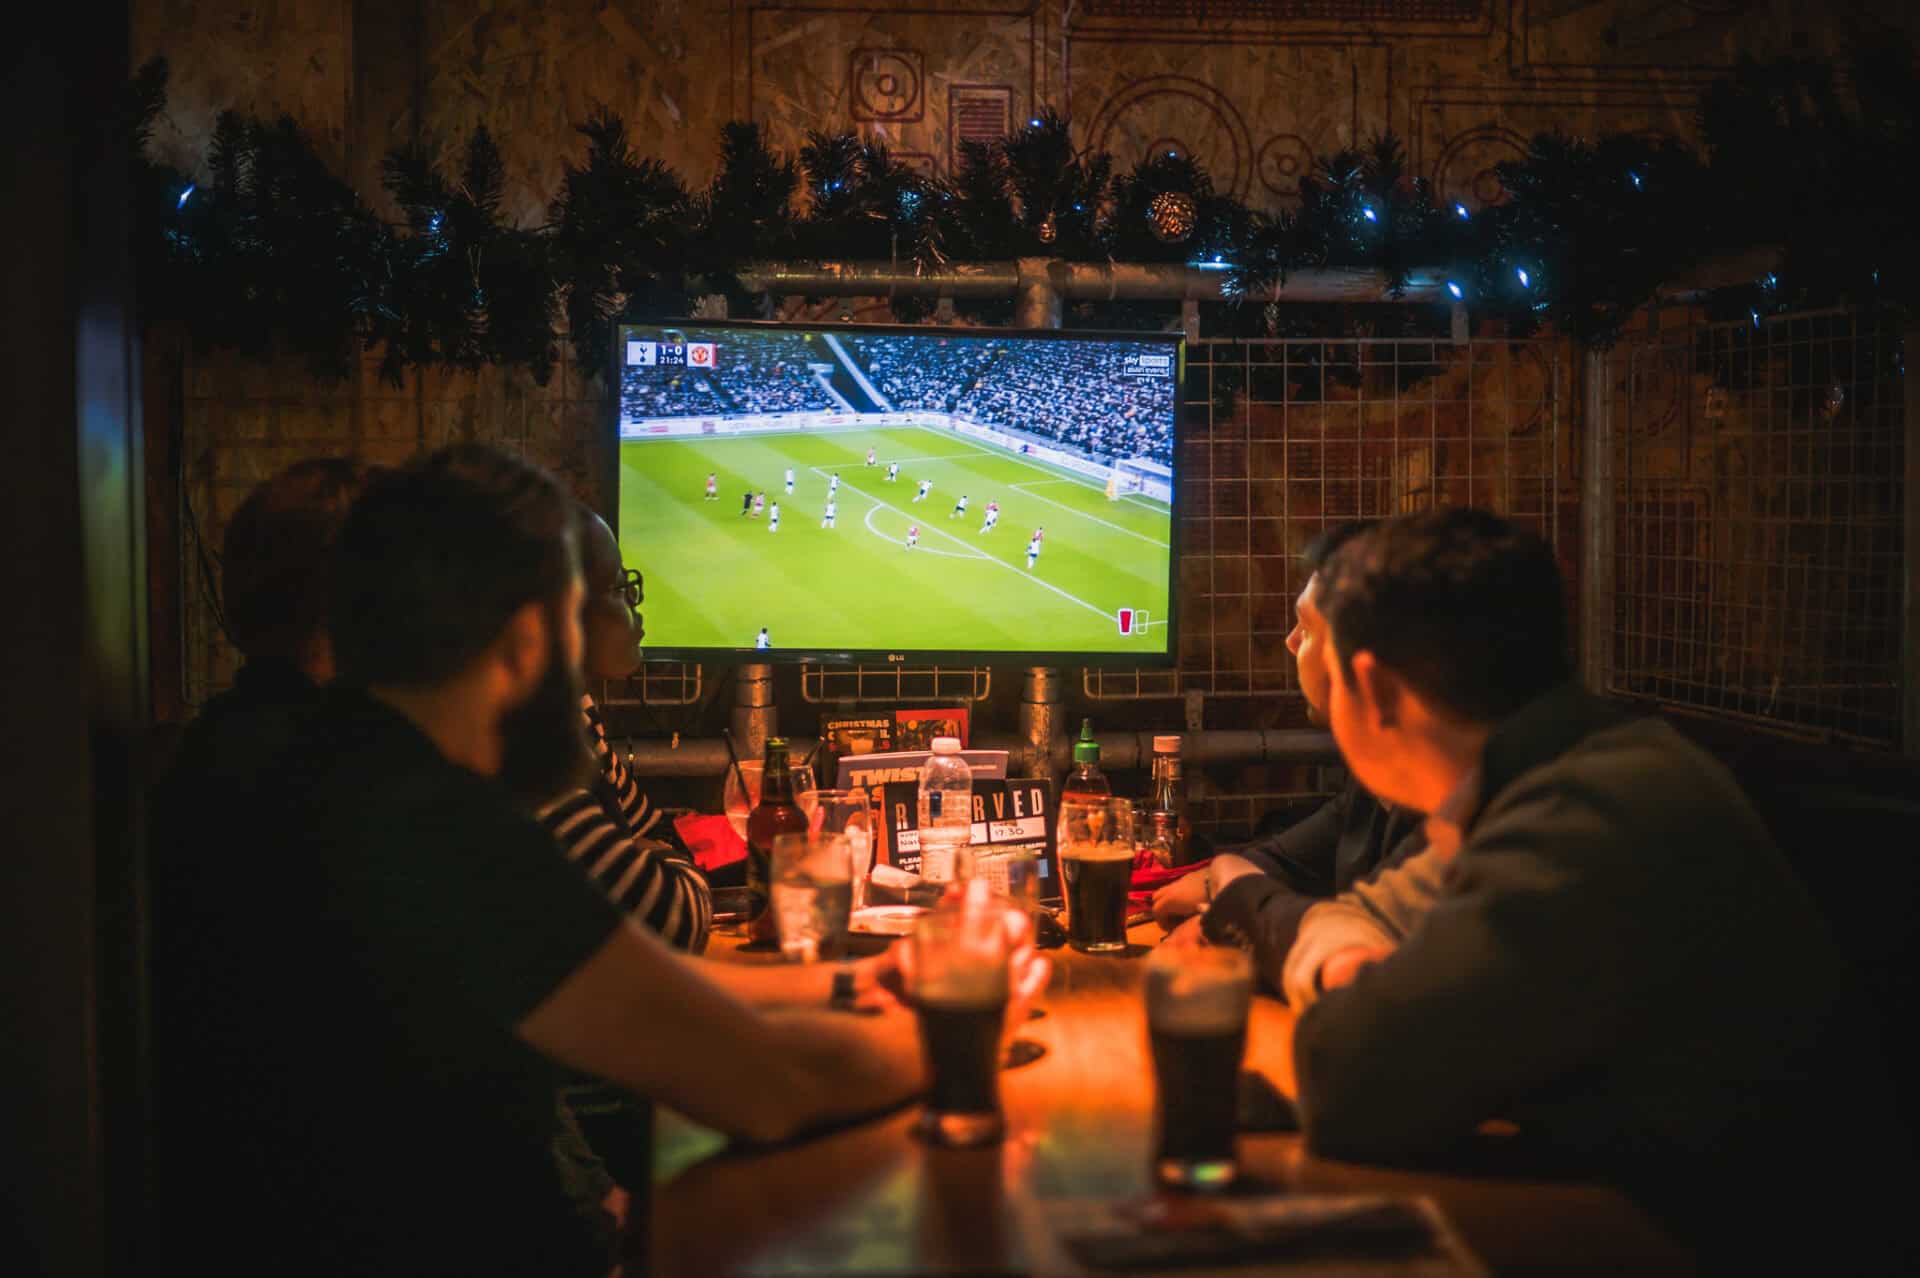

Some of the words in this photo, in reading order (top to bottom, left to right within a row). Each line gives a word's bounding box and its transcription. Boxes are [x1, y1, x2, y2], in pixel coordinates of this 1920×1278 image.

[1124, 356, 1138, 366] sky
[828, 719, 889, 729] CHRISTMAS
[895, 788, 1044, 831] RRVED
